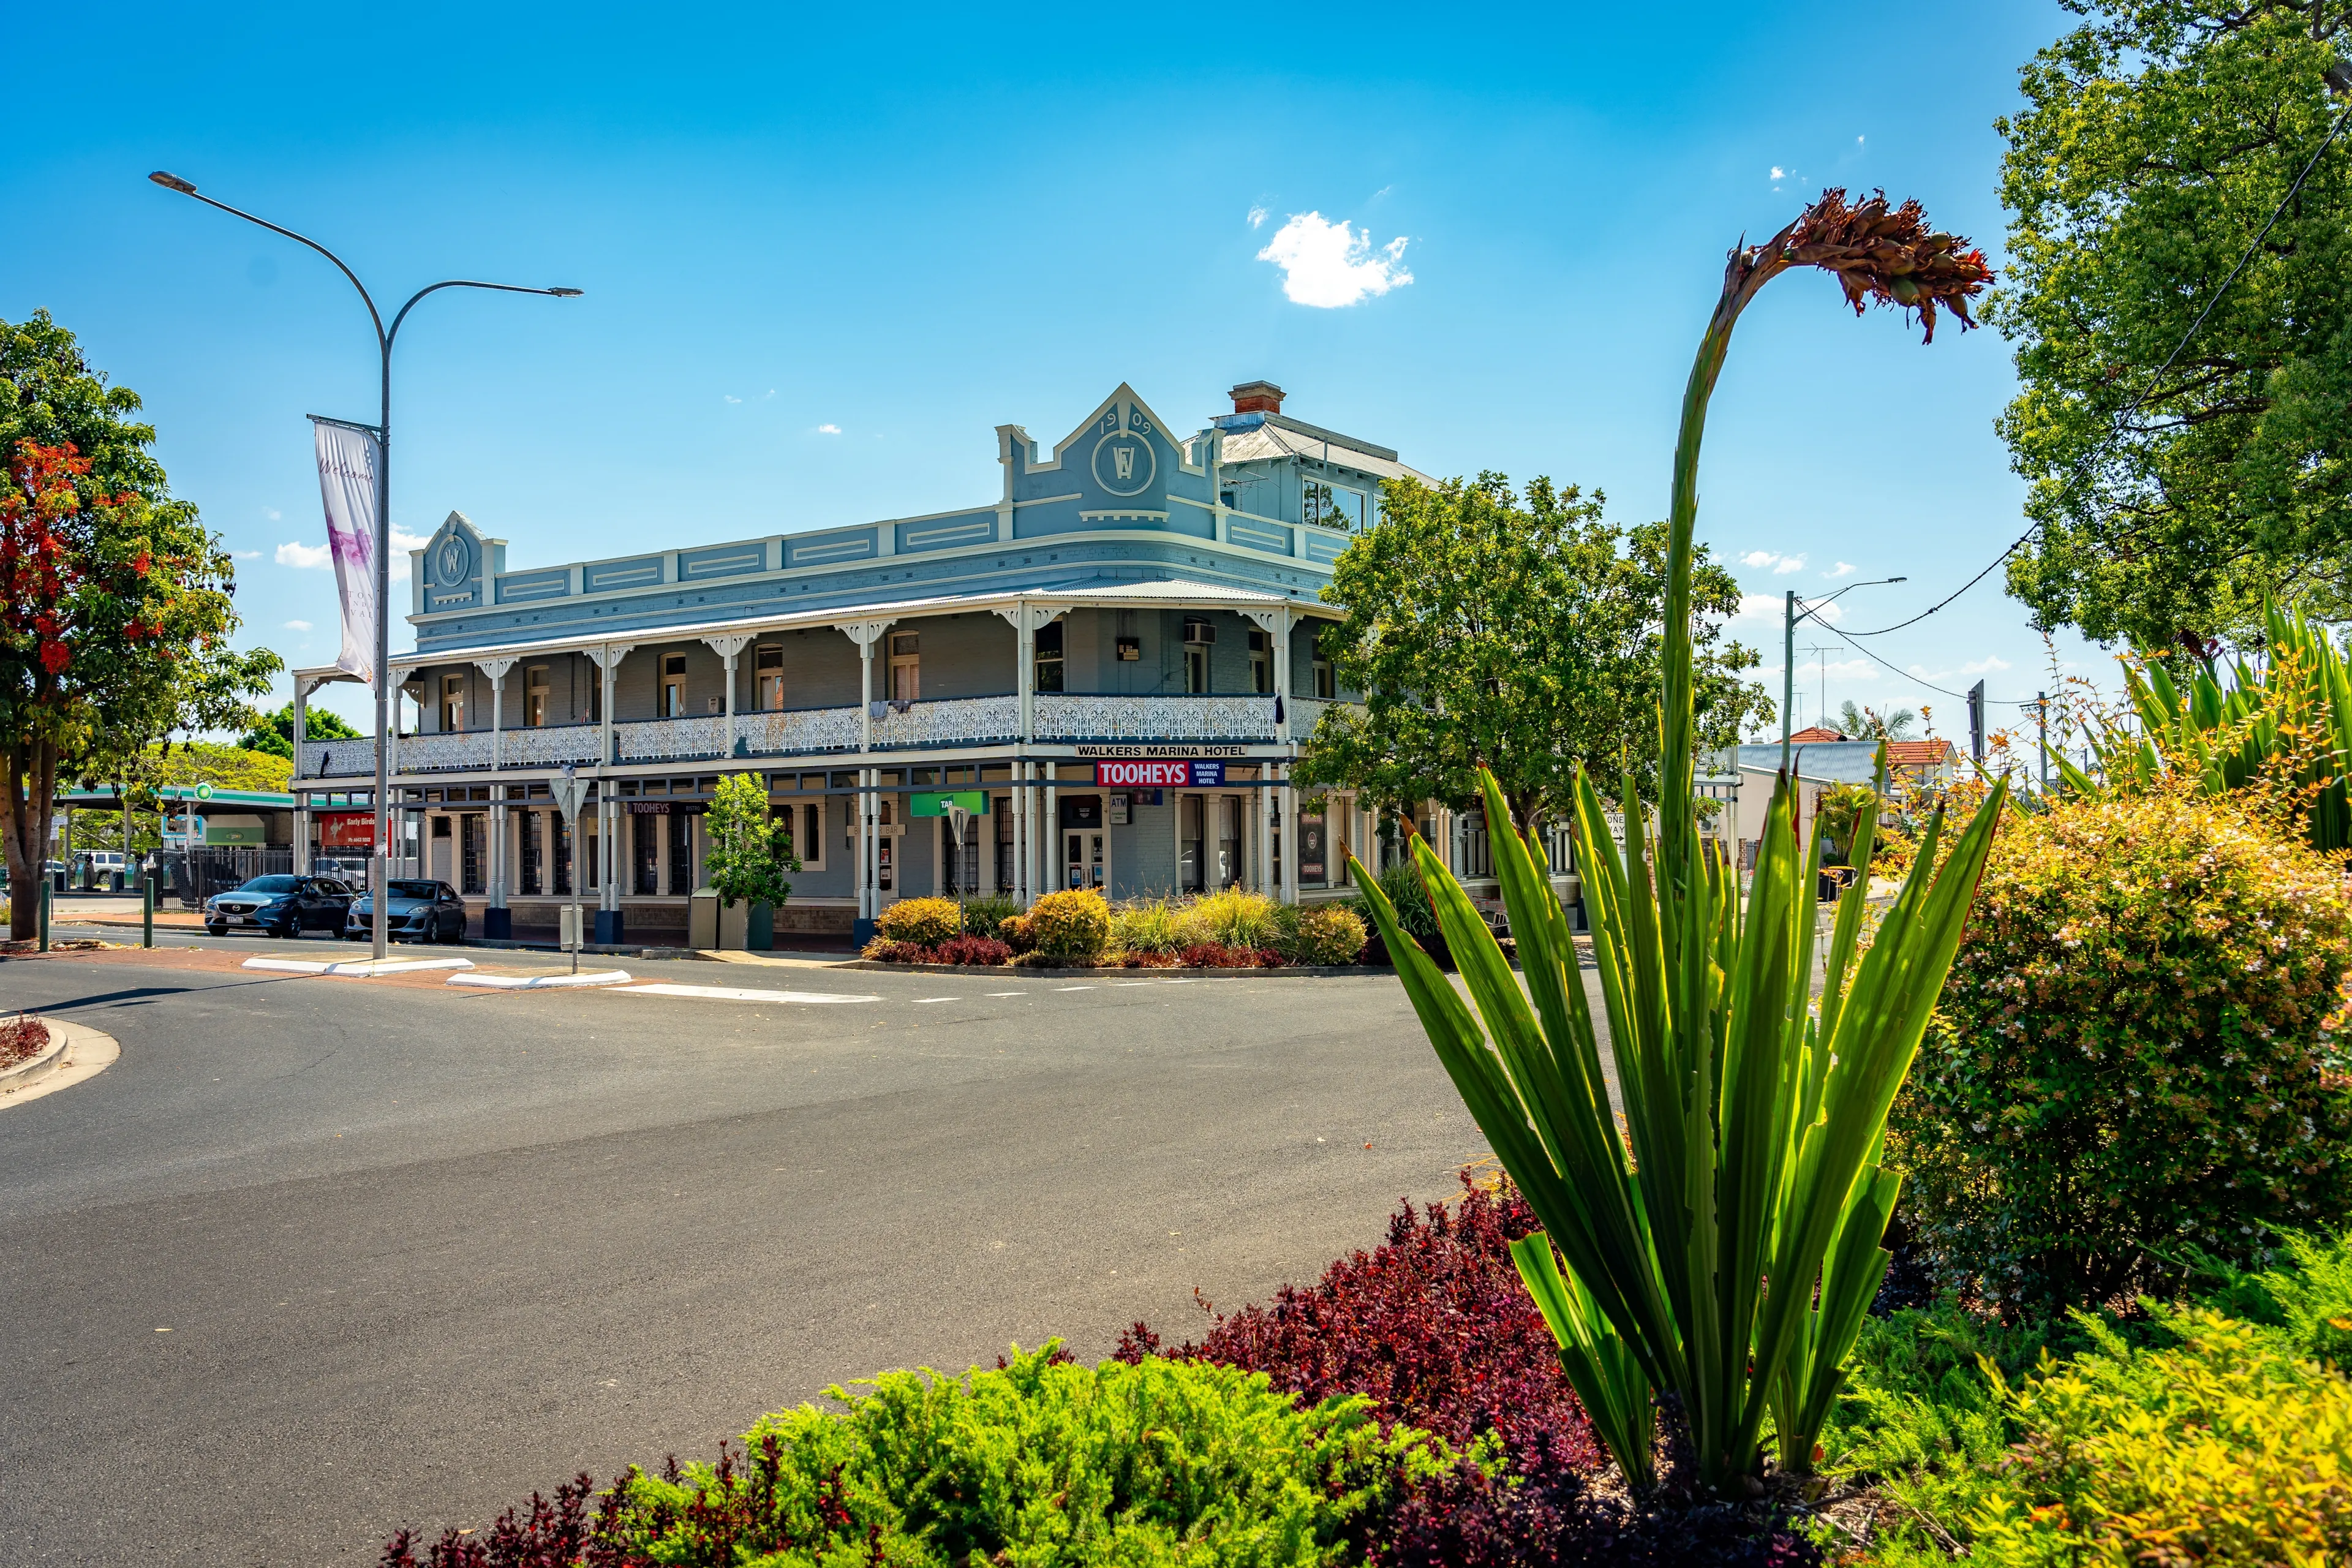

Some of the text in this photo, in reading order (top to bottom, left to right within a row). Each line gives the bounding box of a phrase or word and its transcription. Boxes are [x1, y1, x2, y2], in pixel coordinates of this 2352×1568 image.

[320, 458, 373, 483] Welcome
[1078, 747, 1245, 756] WALKERS MARINA HOTEL
[1101, 764, 1185, 784] TOOHEYS
[1111, 798, 1126, 807] ATM
[633, 803, 669, 813] TOOHEYS
